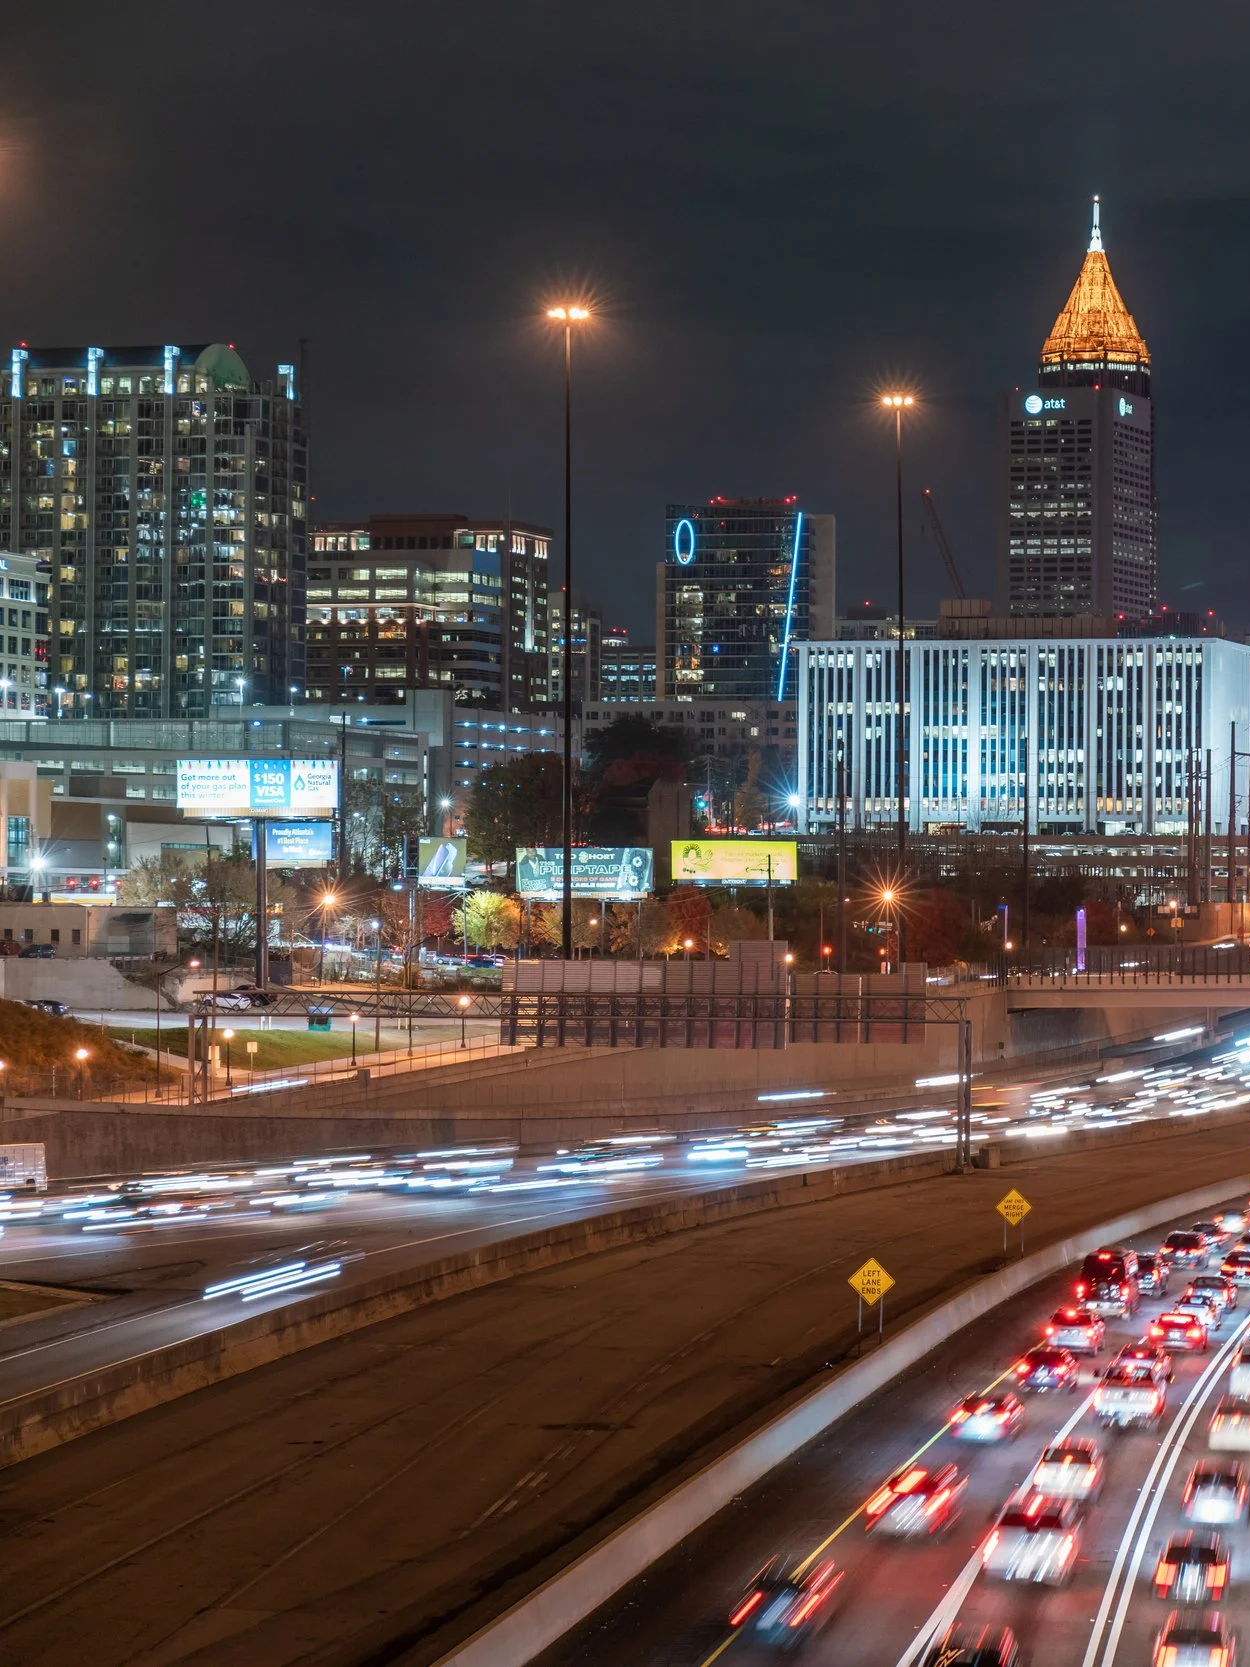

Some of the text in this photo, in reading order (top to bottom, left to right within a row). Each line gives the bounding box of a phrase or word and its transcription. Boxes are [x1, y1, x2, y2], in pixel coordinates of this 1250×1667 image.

[1044, 398, 1065, 409] at&t
[181, 773, 196, 781] Get
[254, 773, 285, 785] $150
[192, 784, 210, 792] your
[229, 783, 247, 791] plan
[255, 786, 285, 797] VISA
[861, 1287, 882, 1295] ENDS
